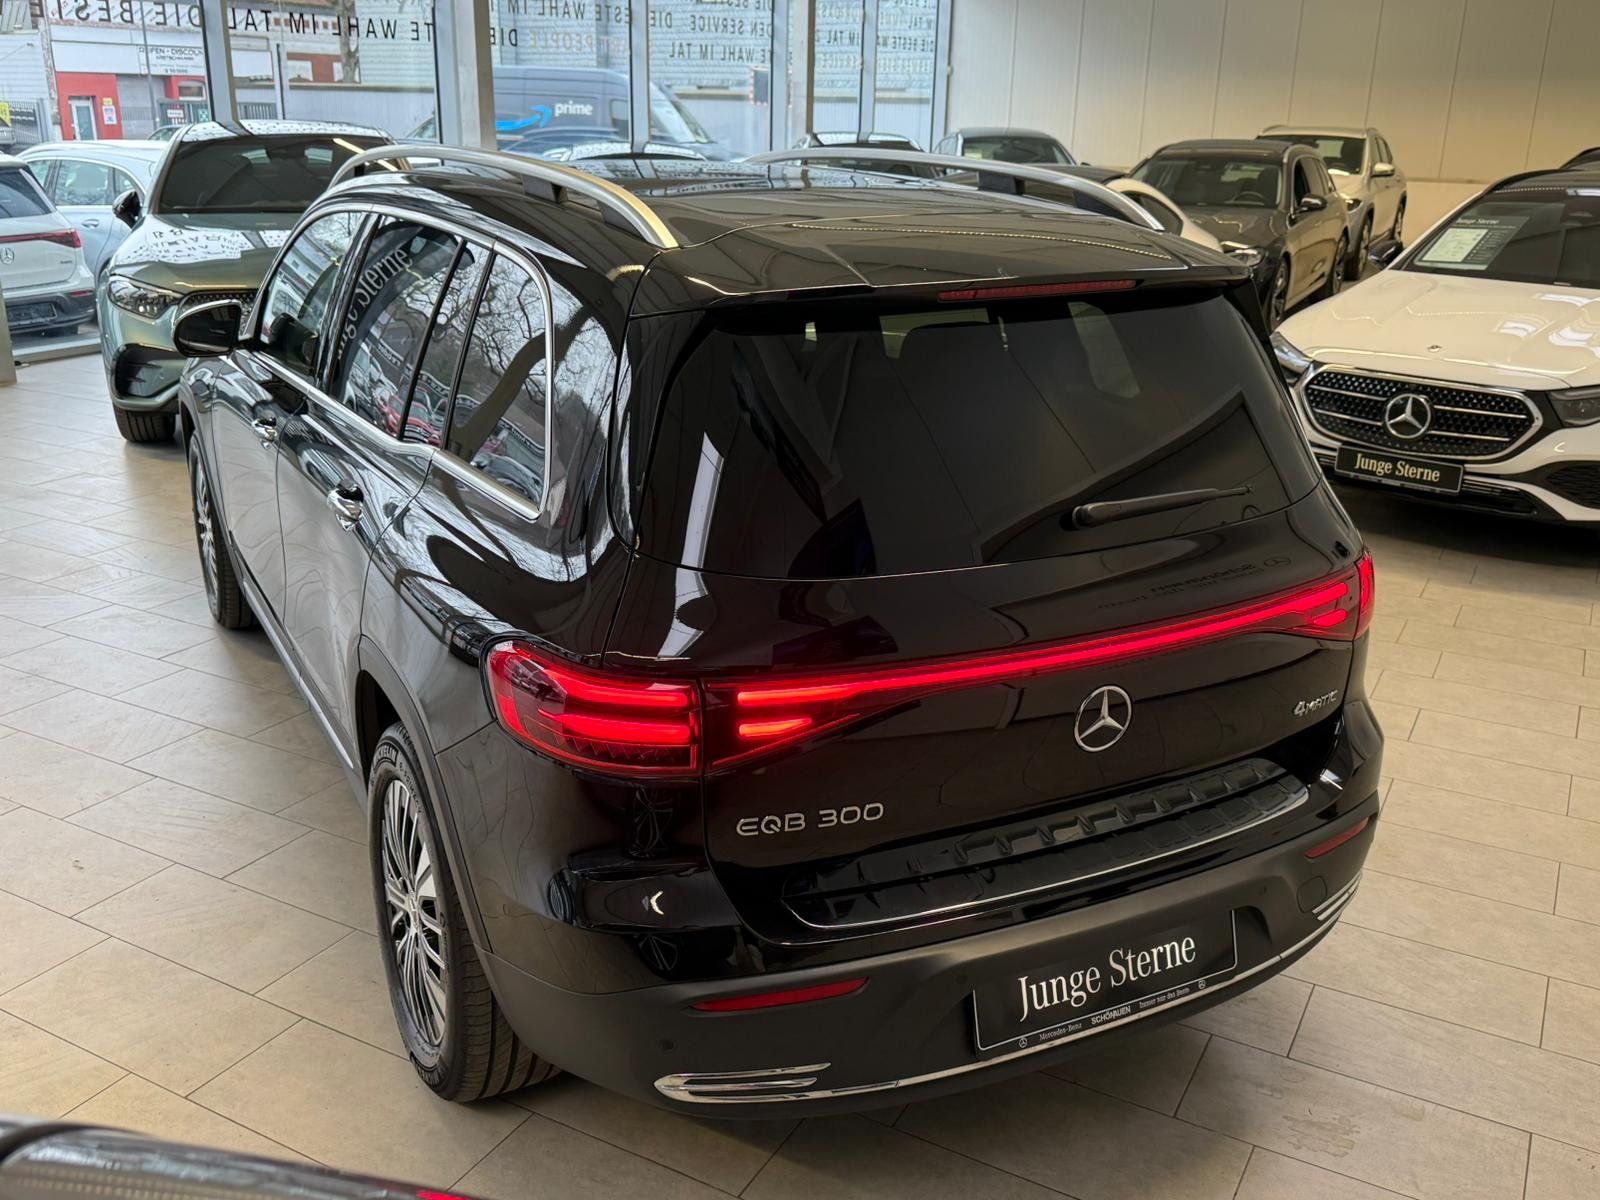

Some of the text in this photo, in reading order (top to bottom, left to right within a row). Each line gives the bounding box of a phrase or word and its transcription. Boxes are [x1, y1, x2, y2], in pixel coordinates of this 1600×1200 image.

[554, 100, 593, 117] prime
[1354, 453, 1440, 482] Junge Sterne
[1293, 690, 1338, 717] 4MATIC
[736, 802, 884, 836] EQB 300
[1017, 937, 1196, 1022] Junge Sterne
[1039, 1022, 1083, 1042] Mercedes-Benz
